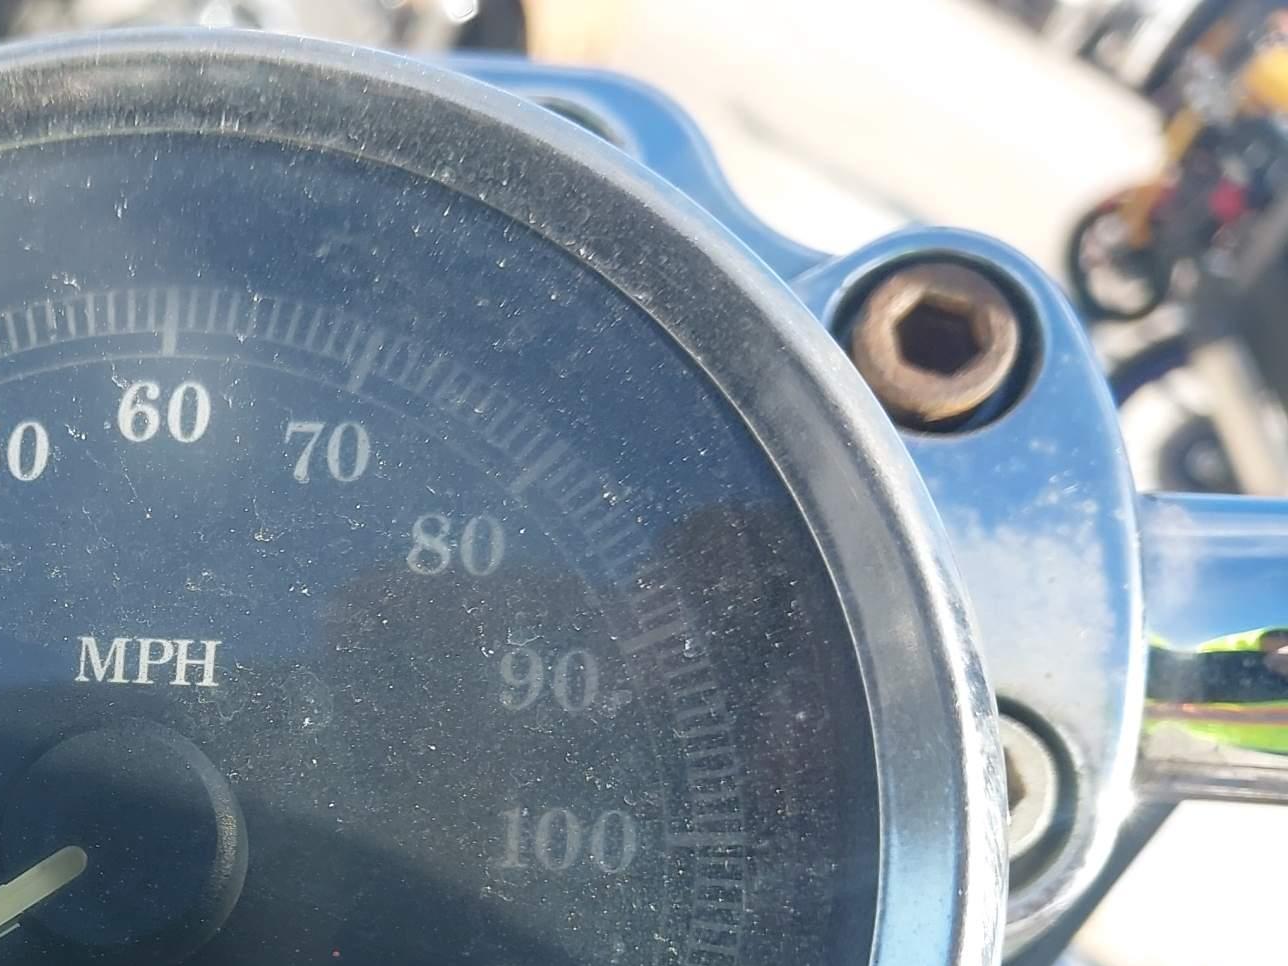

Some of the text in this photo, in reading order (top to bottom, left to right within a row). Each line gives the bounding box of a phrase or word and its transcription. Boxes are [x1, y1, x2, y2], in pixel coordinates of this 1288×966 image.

[117, 380, 212, 444] 60
[283, 420, 373, 484] 70
[406, 512, 508, 577] 80
[74, 635, 223, 687] MPH
[498, 647, 602, 712] 90
[496, 805, 639, 873] 100
